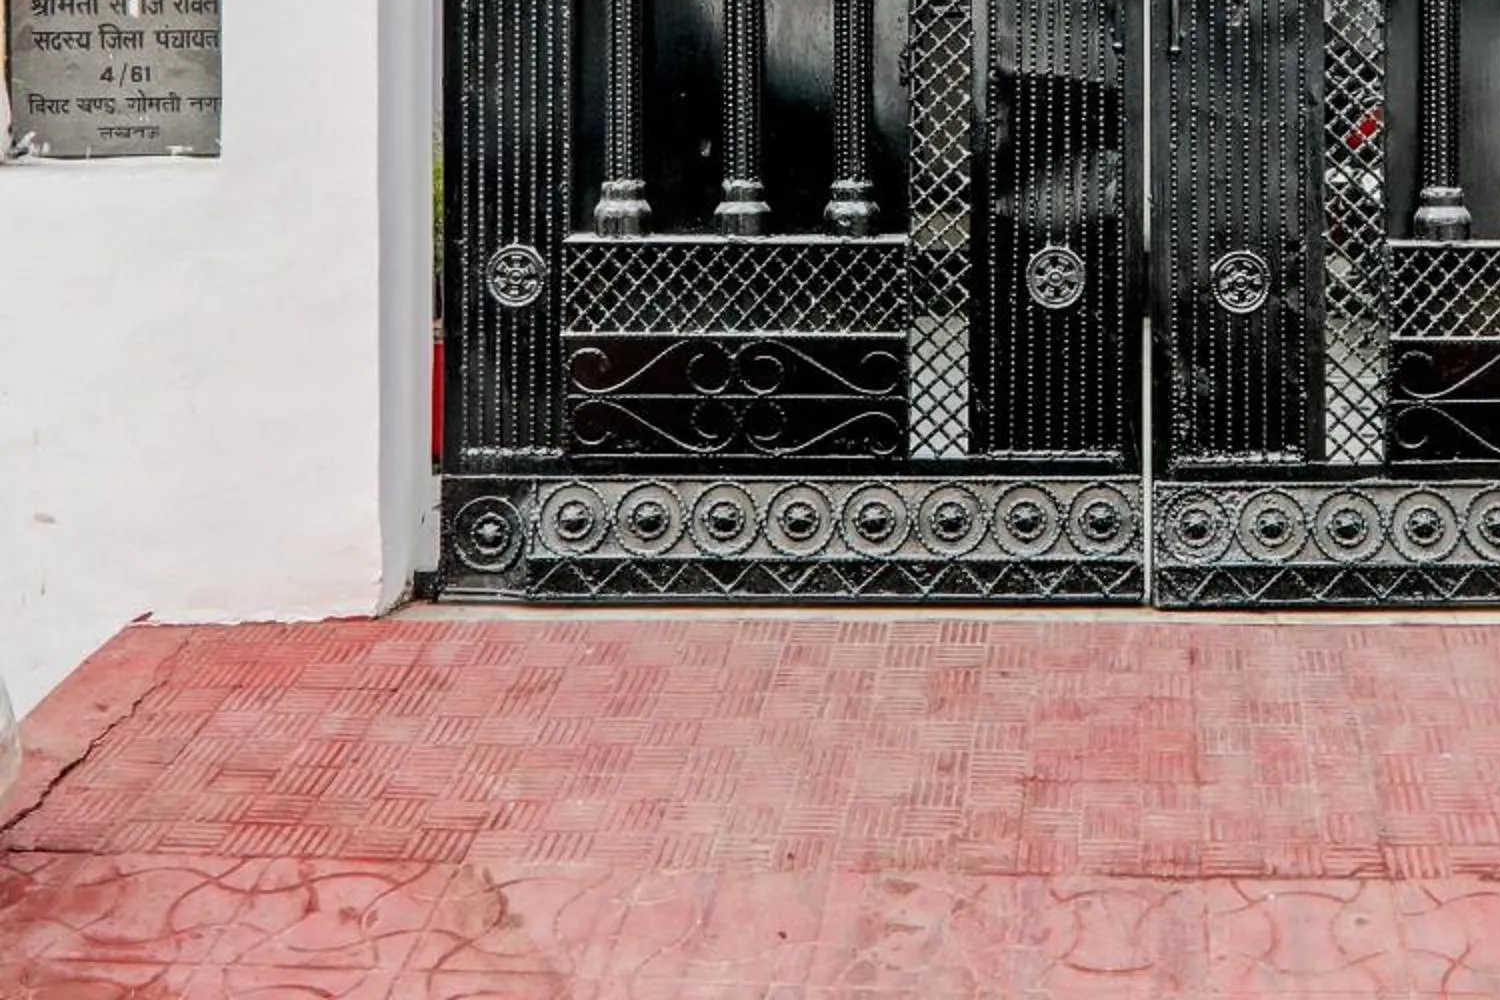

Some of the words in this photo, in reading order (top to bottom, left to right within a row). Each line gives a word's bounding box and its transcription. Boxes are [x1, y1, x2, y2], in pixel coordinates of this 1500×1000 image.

[33, 30, 92, 51] सदस्य
[99, 24, 144, 50] जिला
[155, 25, 221, 49] पंचायत
[28, 94, 70, 115] विराट
[125, 90, 182, 113] गोमती
[188, 98, 222, 113] नग
